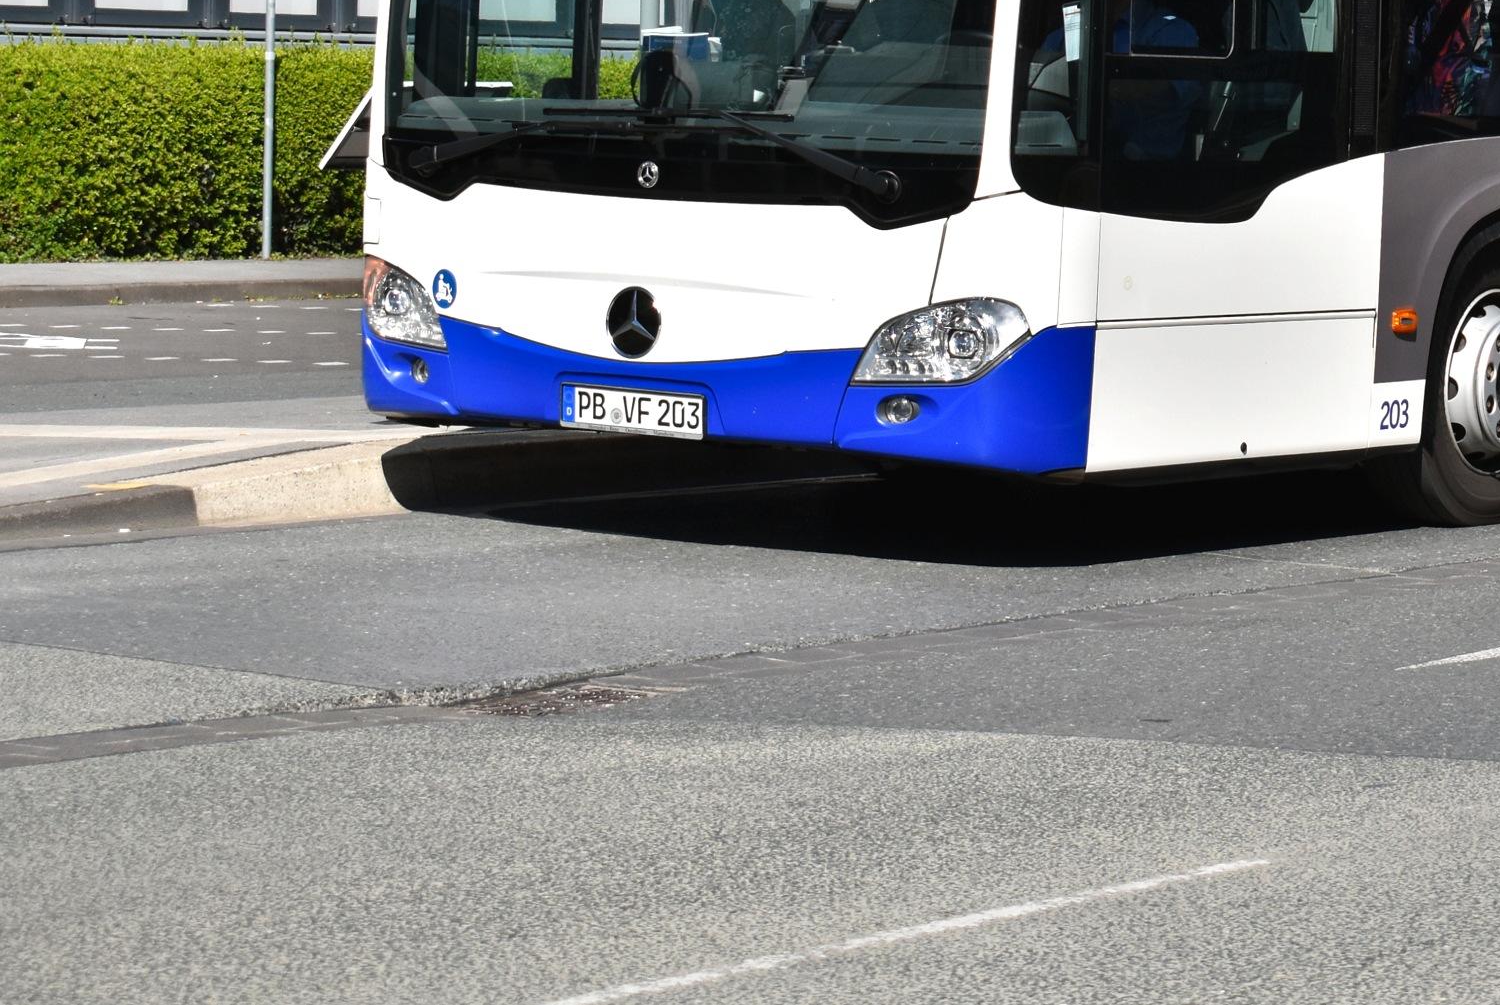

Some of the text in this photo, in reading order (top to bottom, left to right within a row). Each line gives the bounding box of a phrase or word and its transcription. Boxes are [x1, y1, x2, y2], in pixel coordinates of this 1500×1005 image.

[578, 390, 606, 420] PB
[623, 395, 652, 424] VF
[657, 399, 700, 430] 203
[1380, 398, 1409, 431] 203
